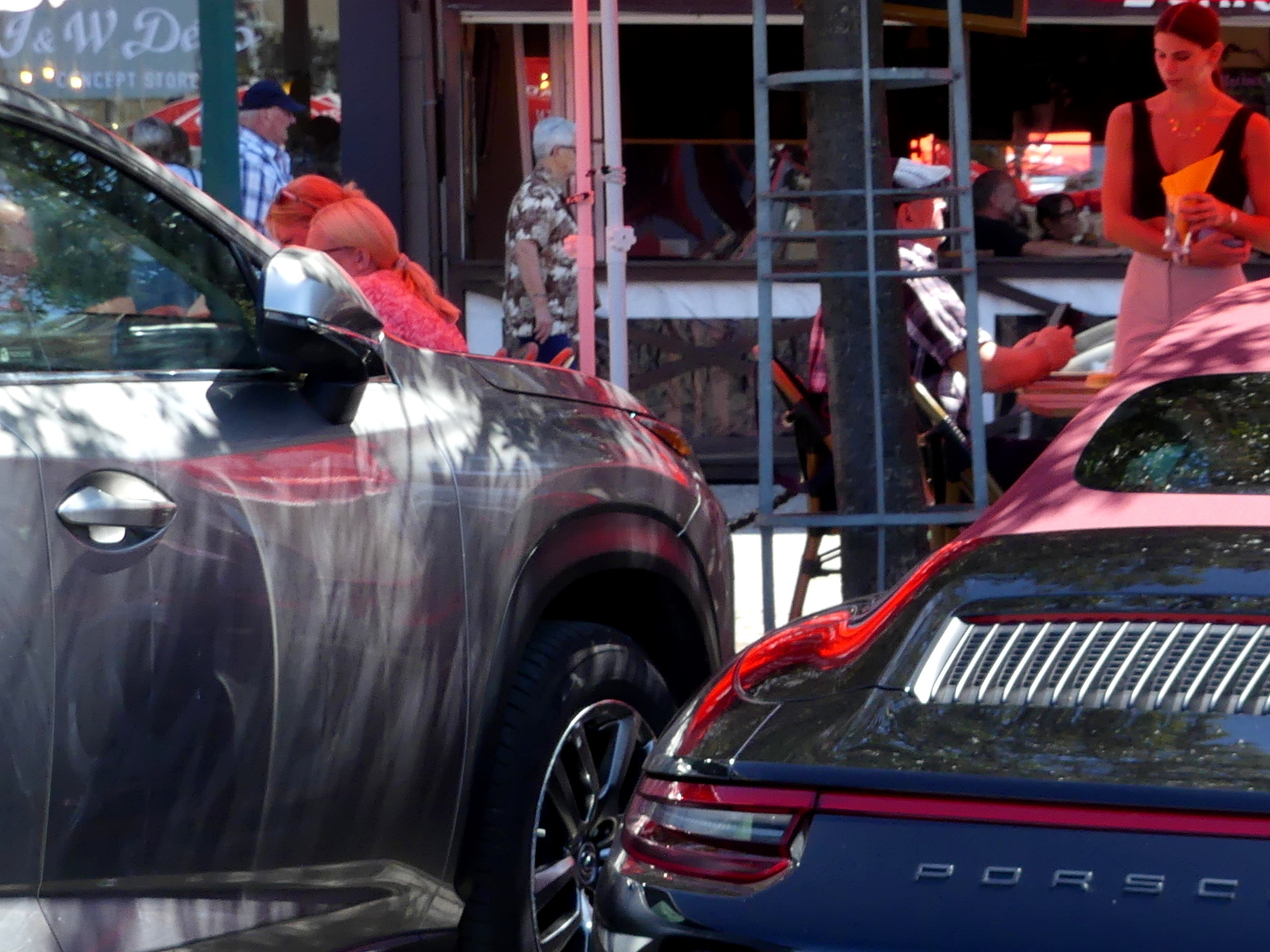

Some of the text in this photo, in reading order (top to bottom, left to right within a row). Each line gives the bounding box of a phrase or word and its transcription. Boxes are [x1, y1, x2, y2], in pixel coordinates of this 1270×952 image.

[32, 26, 55, 54] &
[62, 8, 118, 55] W
[143, 70, 199, 89] STORE
